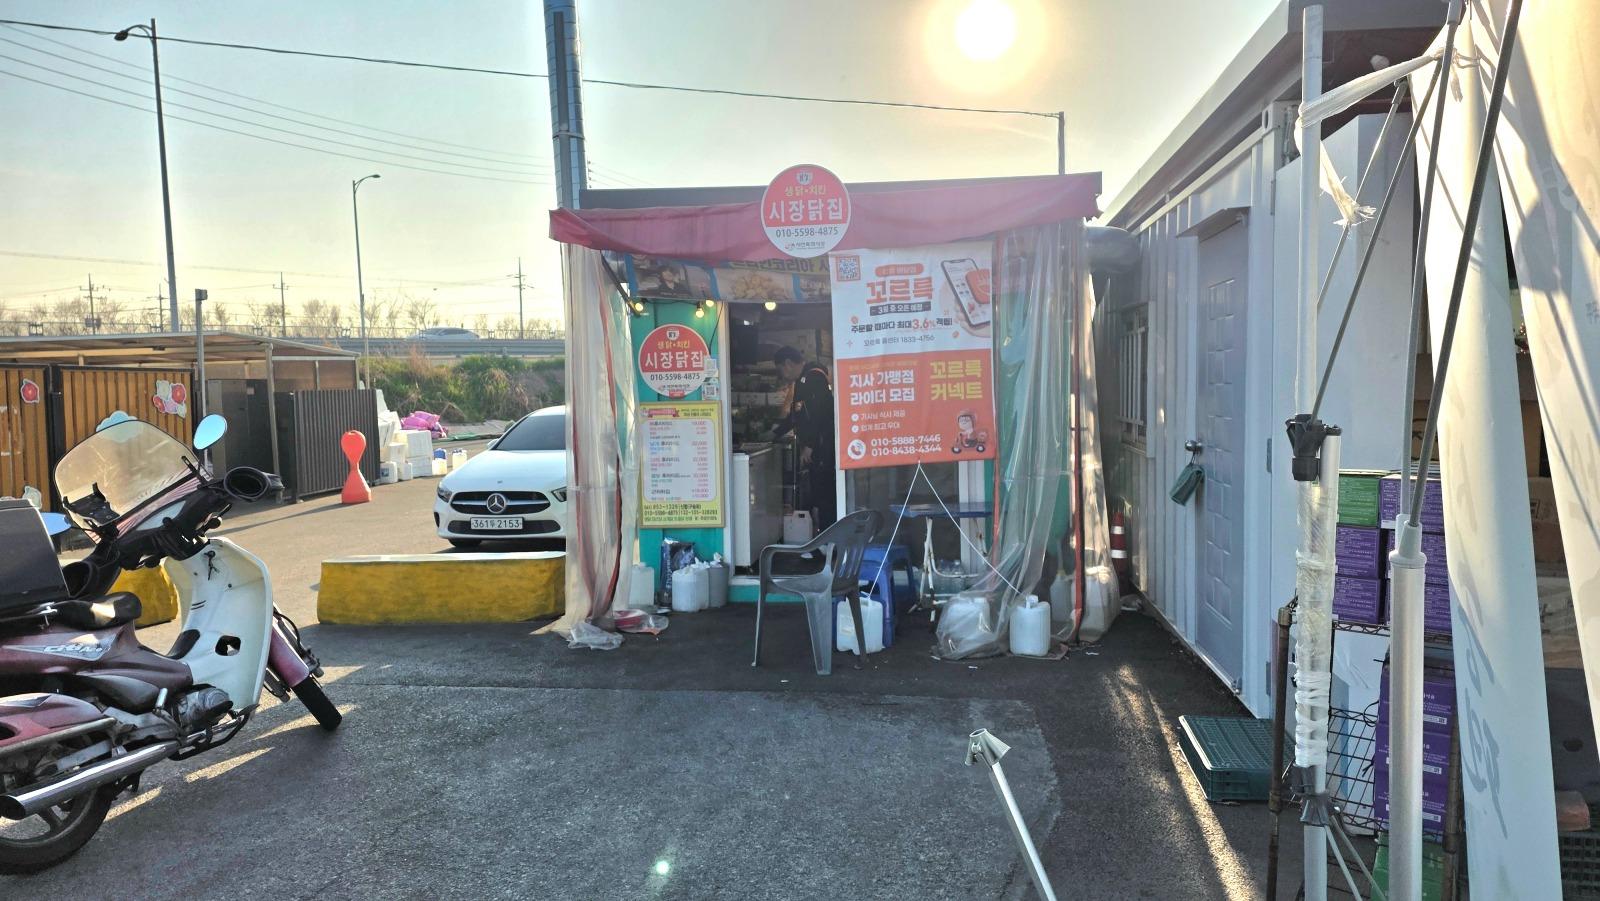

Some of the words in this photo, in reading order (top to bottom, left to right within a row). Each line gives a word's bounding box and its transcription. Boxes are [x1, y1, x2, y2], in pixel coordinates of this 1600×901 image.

[768, 197, 843, 223] 시장닭집
[775, 226, 839, 239] 010-5598-4875
[851, 323, 873, 333] 주문할
[874, 321, 895, 331] 때마다
[645, 350, 704, 369] 시장닭집
[650, 373, 701, 381] 010-5598-4875
[849, 372, 875, 388] 지사
[876, 369, 915, 387] 가맹점
[850, 388, 886, 406] 라이더
[889, 387, 915, 403] 모집
[930, 381, 983, 401] 커넥트
[871, 433, 941, 447] 010-5888-7446
[871, 443, 942, 457] 010-8438-4344
[497, 519, 520, 529] 2153
